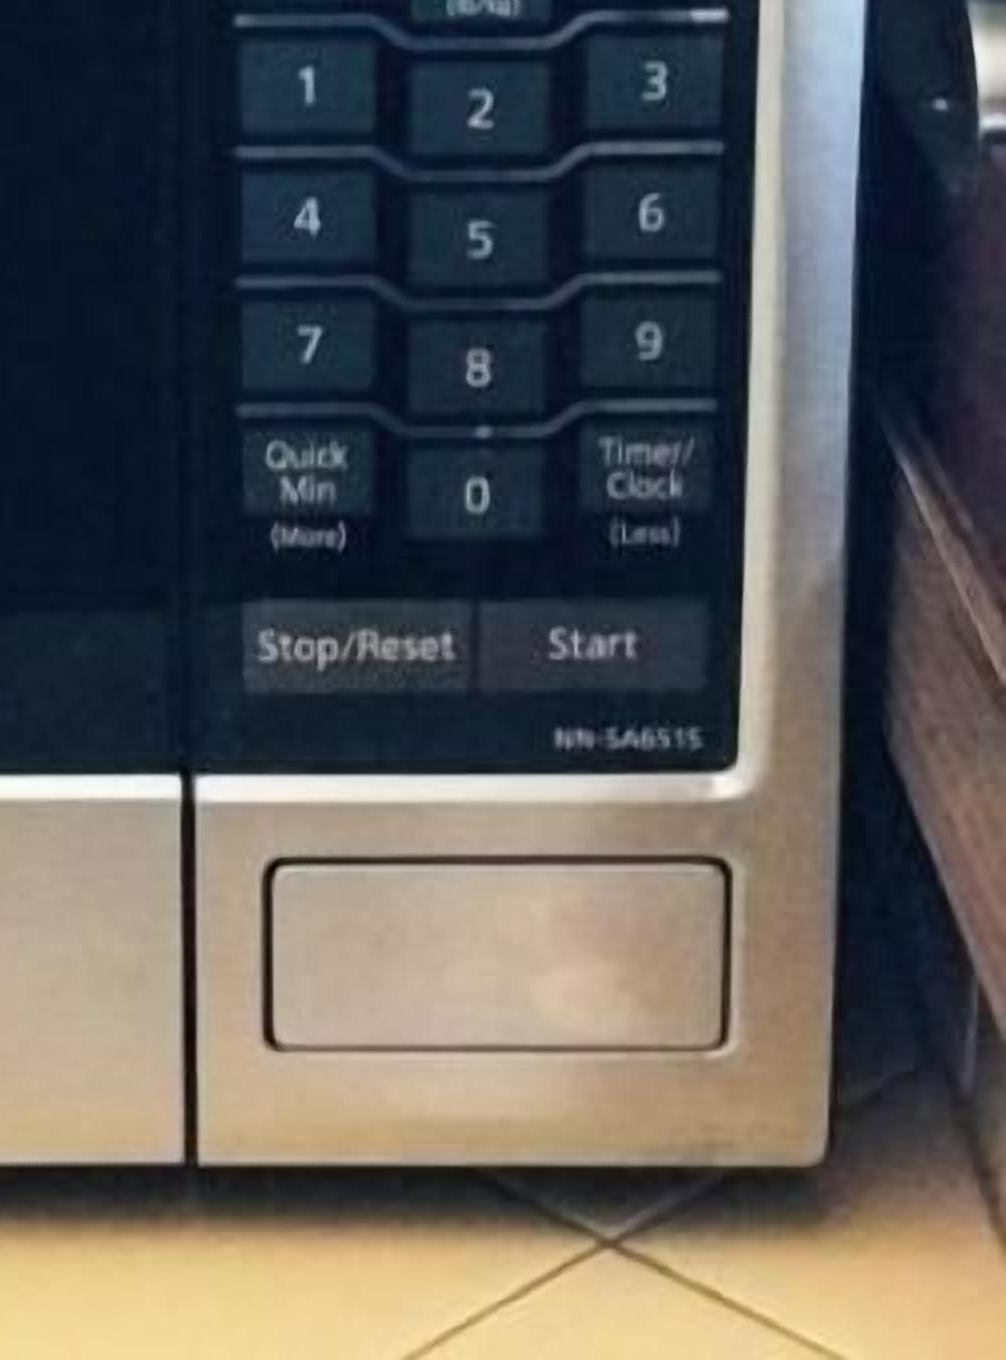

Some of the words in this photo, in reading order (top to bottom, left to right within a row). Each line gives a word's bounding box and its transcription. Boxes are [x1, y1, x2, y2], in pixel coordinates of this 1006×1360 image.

[298, 65, 317, 106] 1
[640, 60, 669, 102] 3
[466, 87, 495, 129] 2
[293, 196, 322, 237] 4
[636, 192, 665, 233] 6
[466, 219, 494, 259] 5
[297, 324, 323, 364] 7
[634, 320, 664, 361] 9
[465, 347, 493, 388] 8
[265, 440, 349, 473] Quick
[598, 435, 696, 470] Timer/
[280, 476, 337, 504] Min
[464, 476, 491, 515] 0
[606, 470, 683, 501] Clock
[270, 520, 347, 551] (More)
[609, 516, 682, 547] (Less)
[256, 628, 456, 670] Stop/Reset
[548, 626, 639, 662] Start
